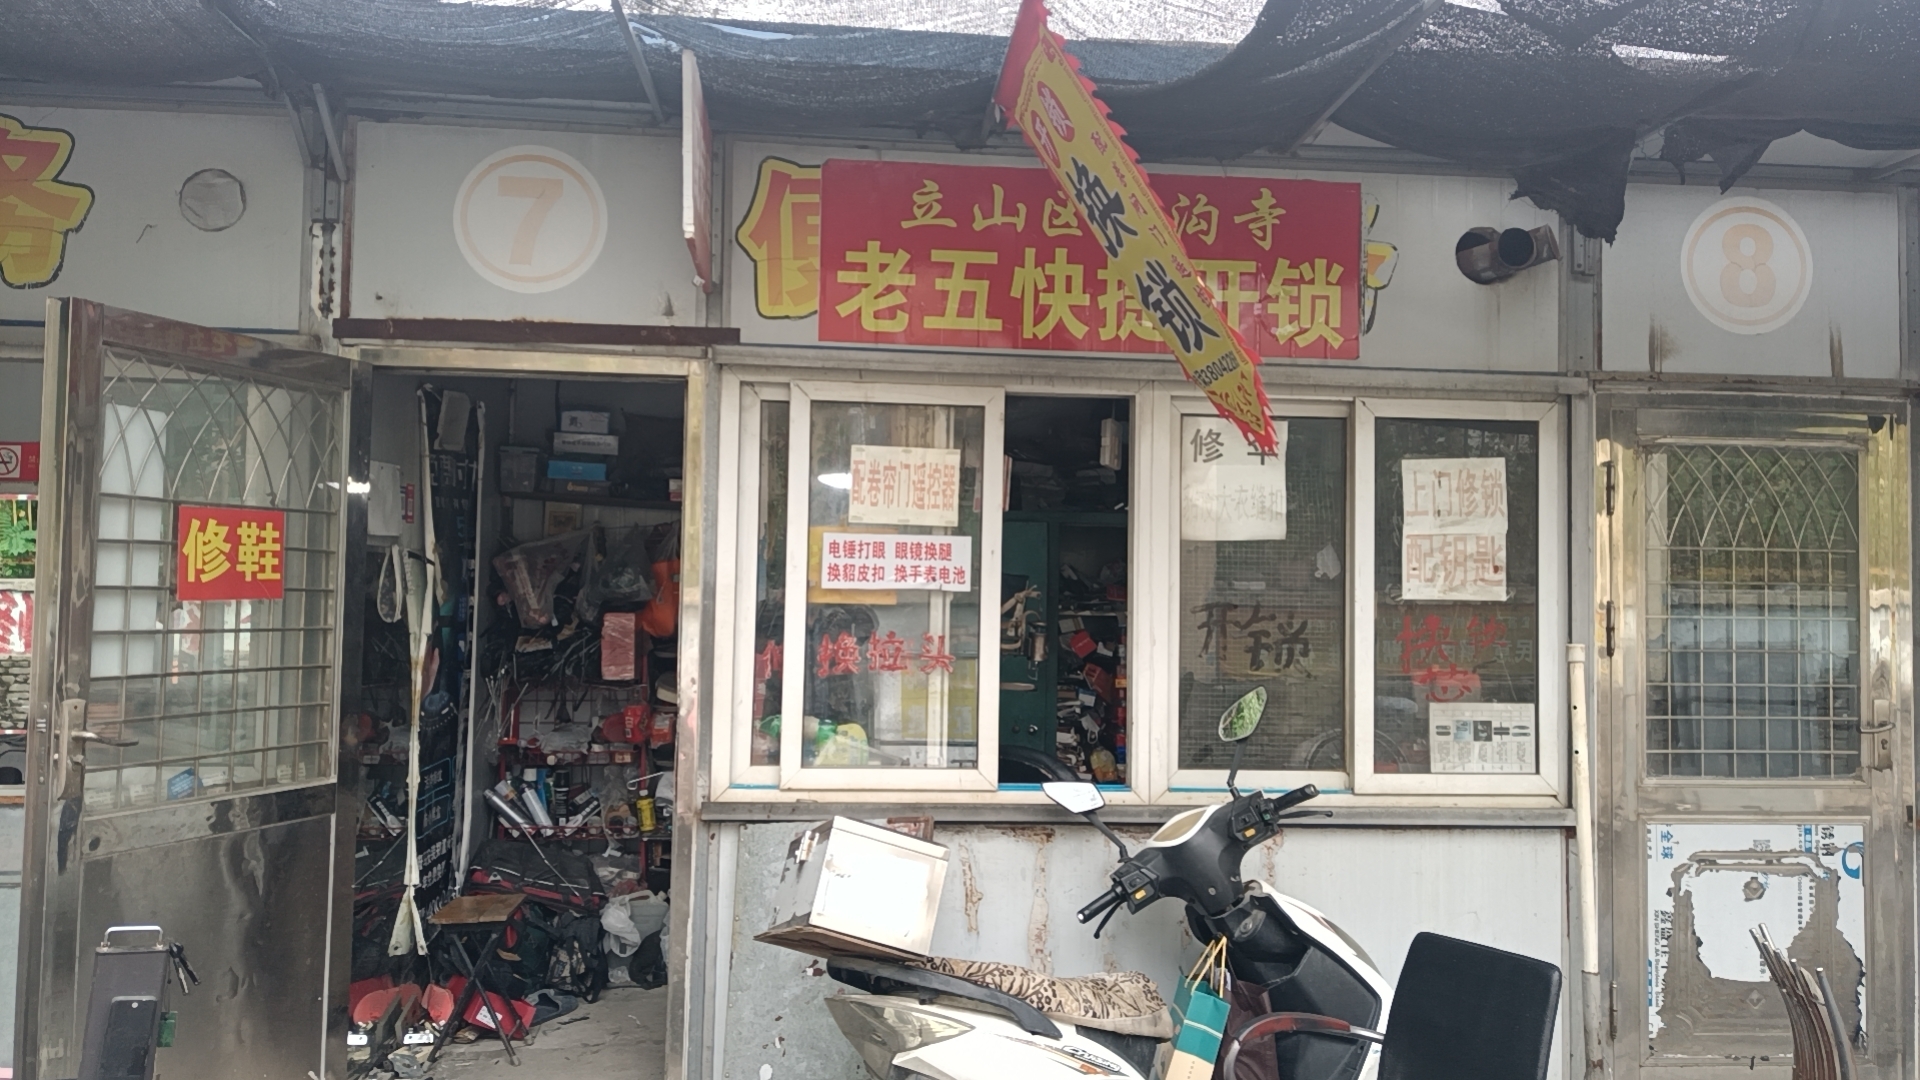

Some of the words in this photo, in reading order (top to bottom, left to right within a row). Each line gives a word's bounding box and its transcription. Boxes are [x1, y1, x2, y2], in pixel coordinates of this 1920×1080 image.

[497, 175, 564, 266] 7
[901, 179, 1287, 251] 立山区沟寺
[1065, 156, 1221, 354] 换锁
[1720, 223, 1777, 308] 8
[852, 459, 956, 512] 配卷帘门遥控器
[1406, 467, 1505, 519] 上门修锁
[182, 518, 281, 583] 修鞋
[829, 540, 886, 560] 电锤打眼
[895, 541, 953, 562] 眼镜换腿
[894, 564, 966, 585] 换手表电池
[1406, 534, 1504, 587] 配钥匙
[1190, 601, 1318, 680] 开锁
